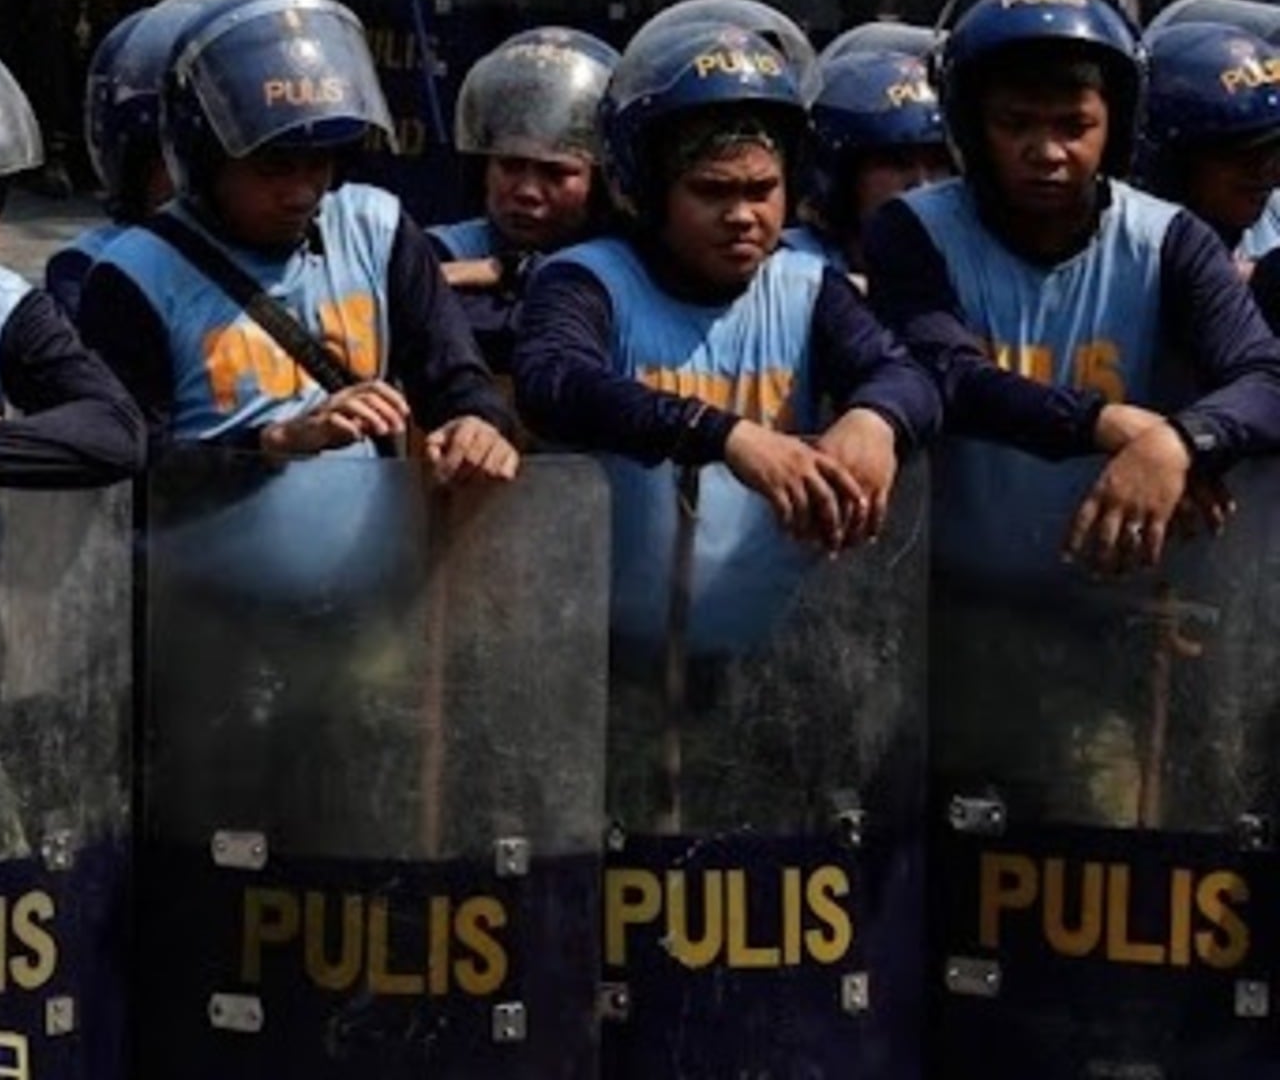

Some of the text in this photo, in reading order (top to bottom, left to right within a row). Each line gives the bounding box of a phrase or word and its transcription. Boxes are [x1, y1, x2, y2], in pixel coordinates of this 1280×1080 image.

[244, 886, 508, 996] PULIS
[605, 865, 852, 969] PULIS
[979, 852, 1250, 968] PULIS
